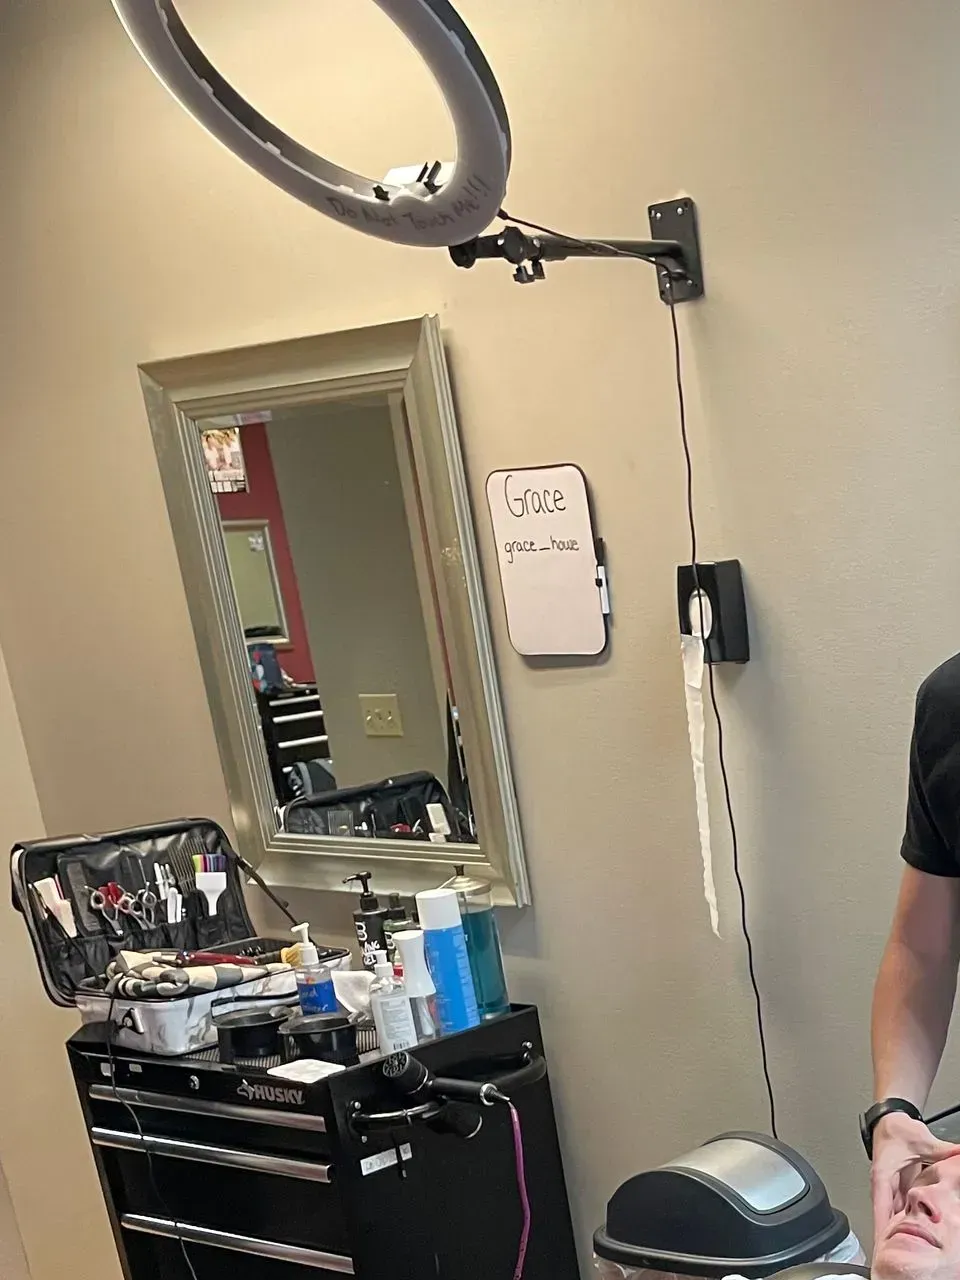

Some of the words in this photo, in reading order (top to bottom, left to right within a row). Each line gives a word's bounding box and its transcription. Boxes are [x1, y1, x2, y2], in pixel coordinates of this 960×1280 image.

[326, 197, 357, 218] Do
[504, 474, 567, 518] Grace
[253, 1083, 306, 1105] HUSKY
